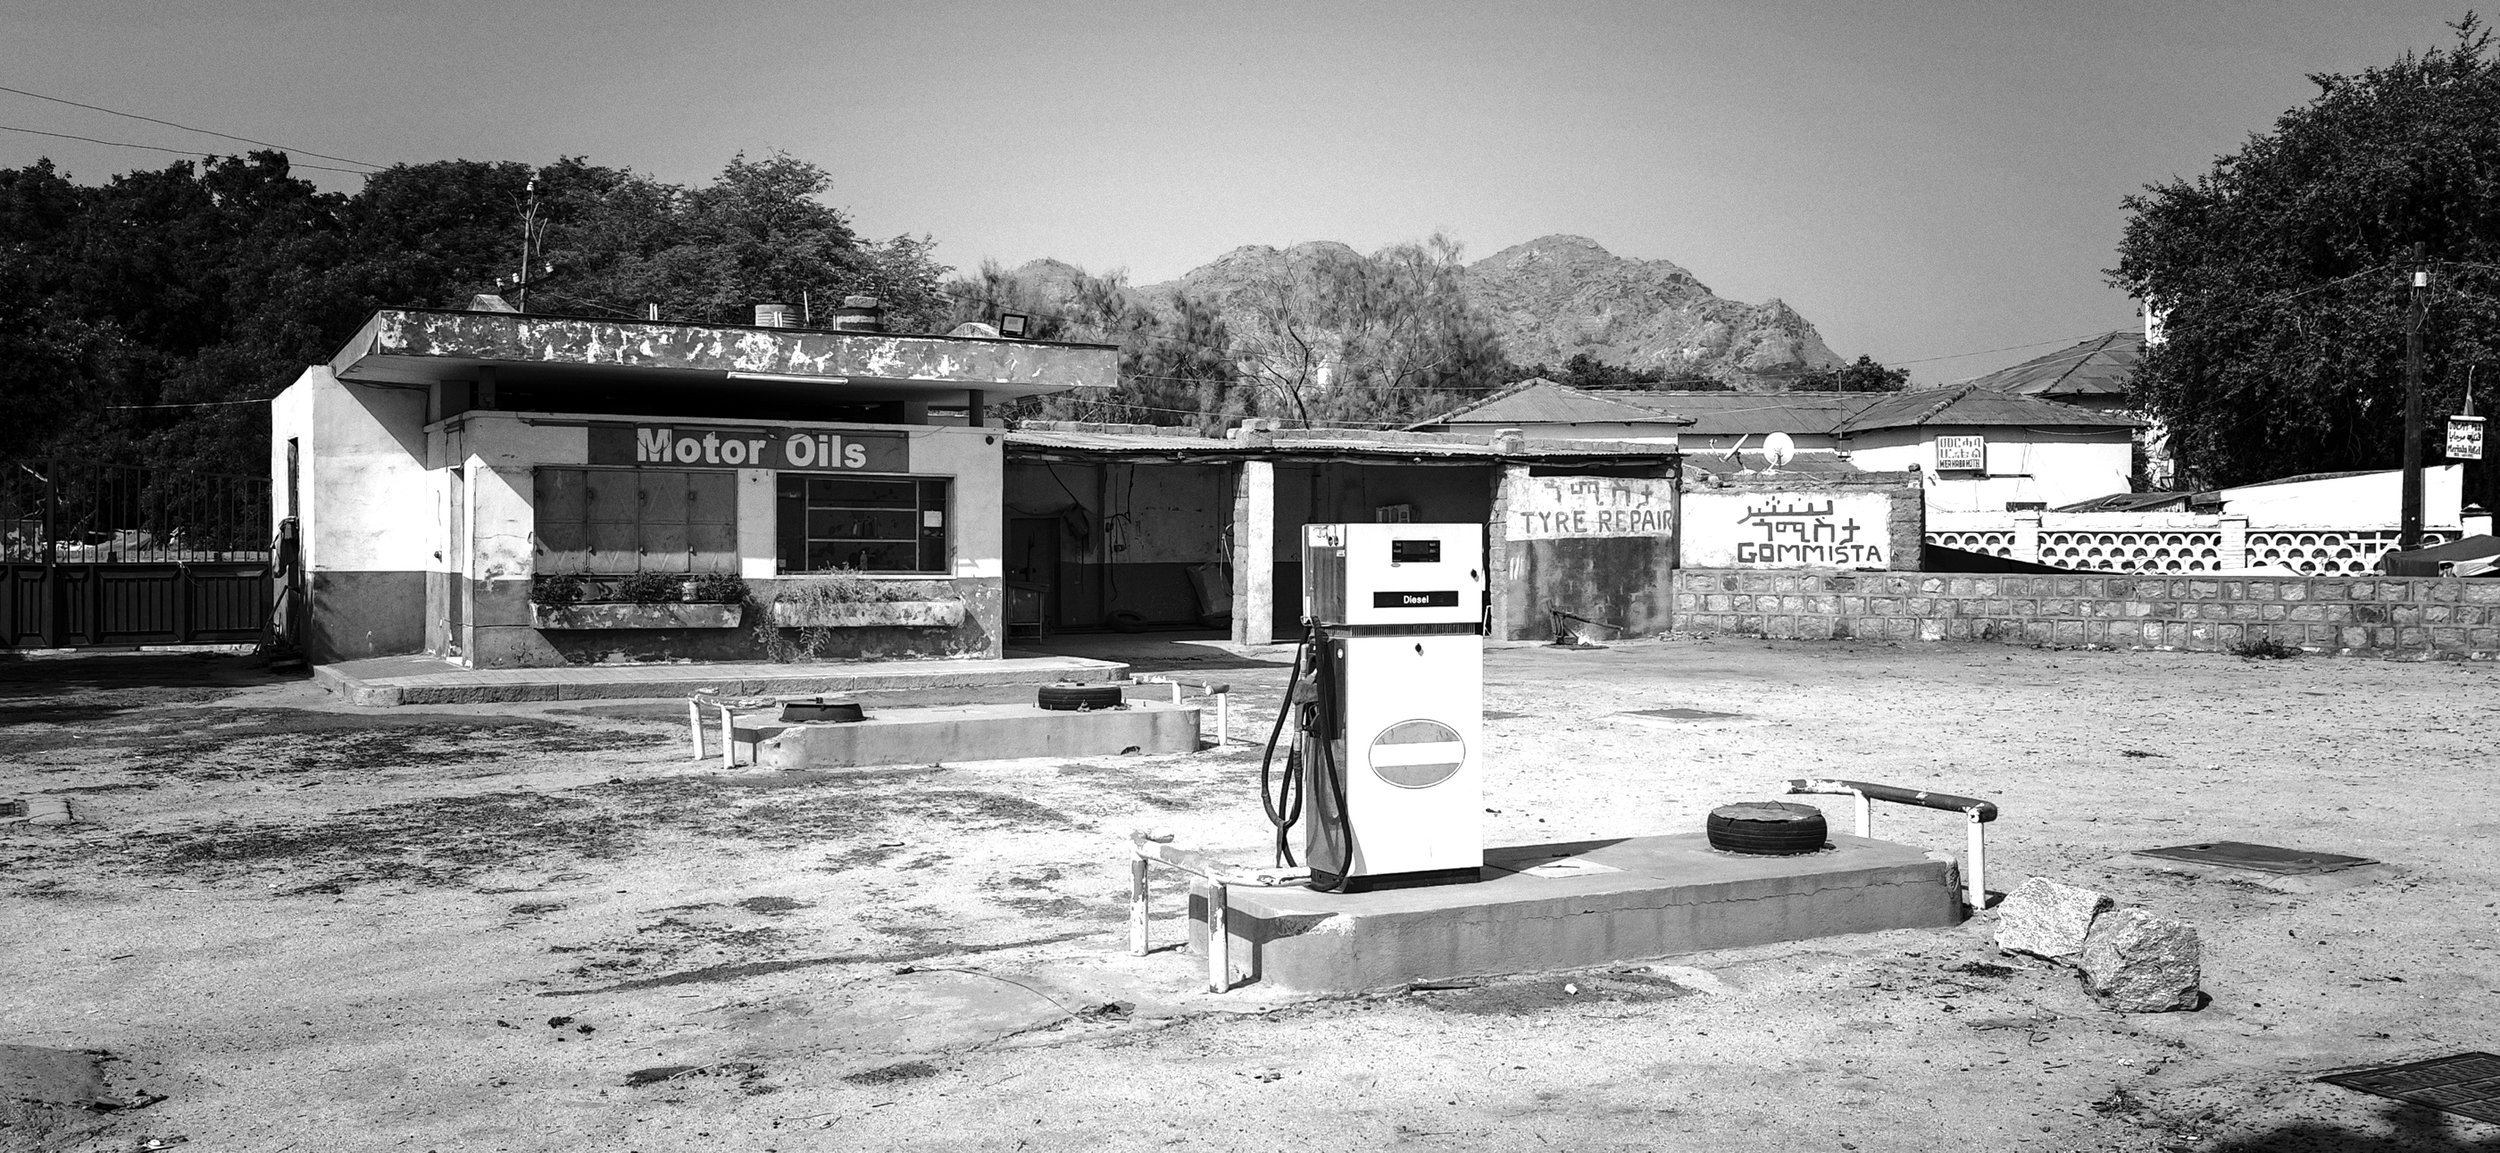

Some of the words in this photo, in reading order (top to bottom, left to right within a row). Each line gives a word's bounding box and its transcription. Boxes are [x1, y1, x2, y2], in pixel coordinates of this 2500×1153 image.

[636, 427, 767, 465] Motor
[785, 433, 868, 468] Oils
[1520, 511, 1588, 534] TYRE
[1598, 509, 1673, 533] REPAIR
[1737, 542, 1882, 565] GOMMISTA
[1403, 595, 1429, 604] Diesel
